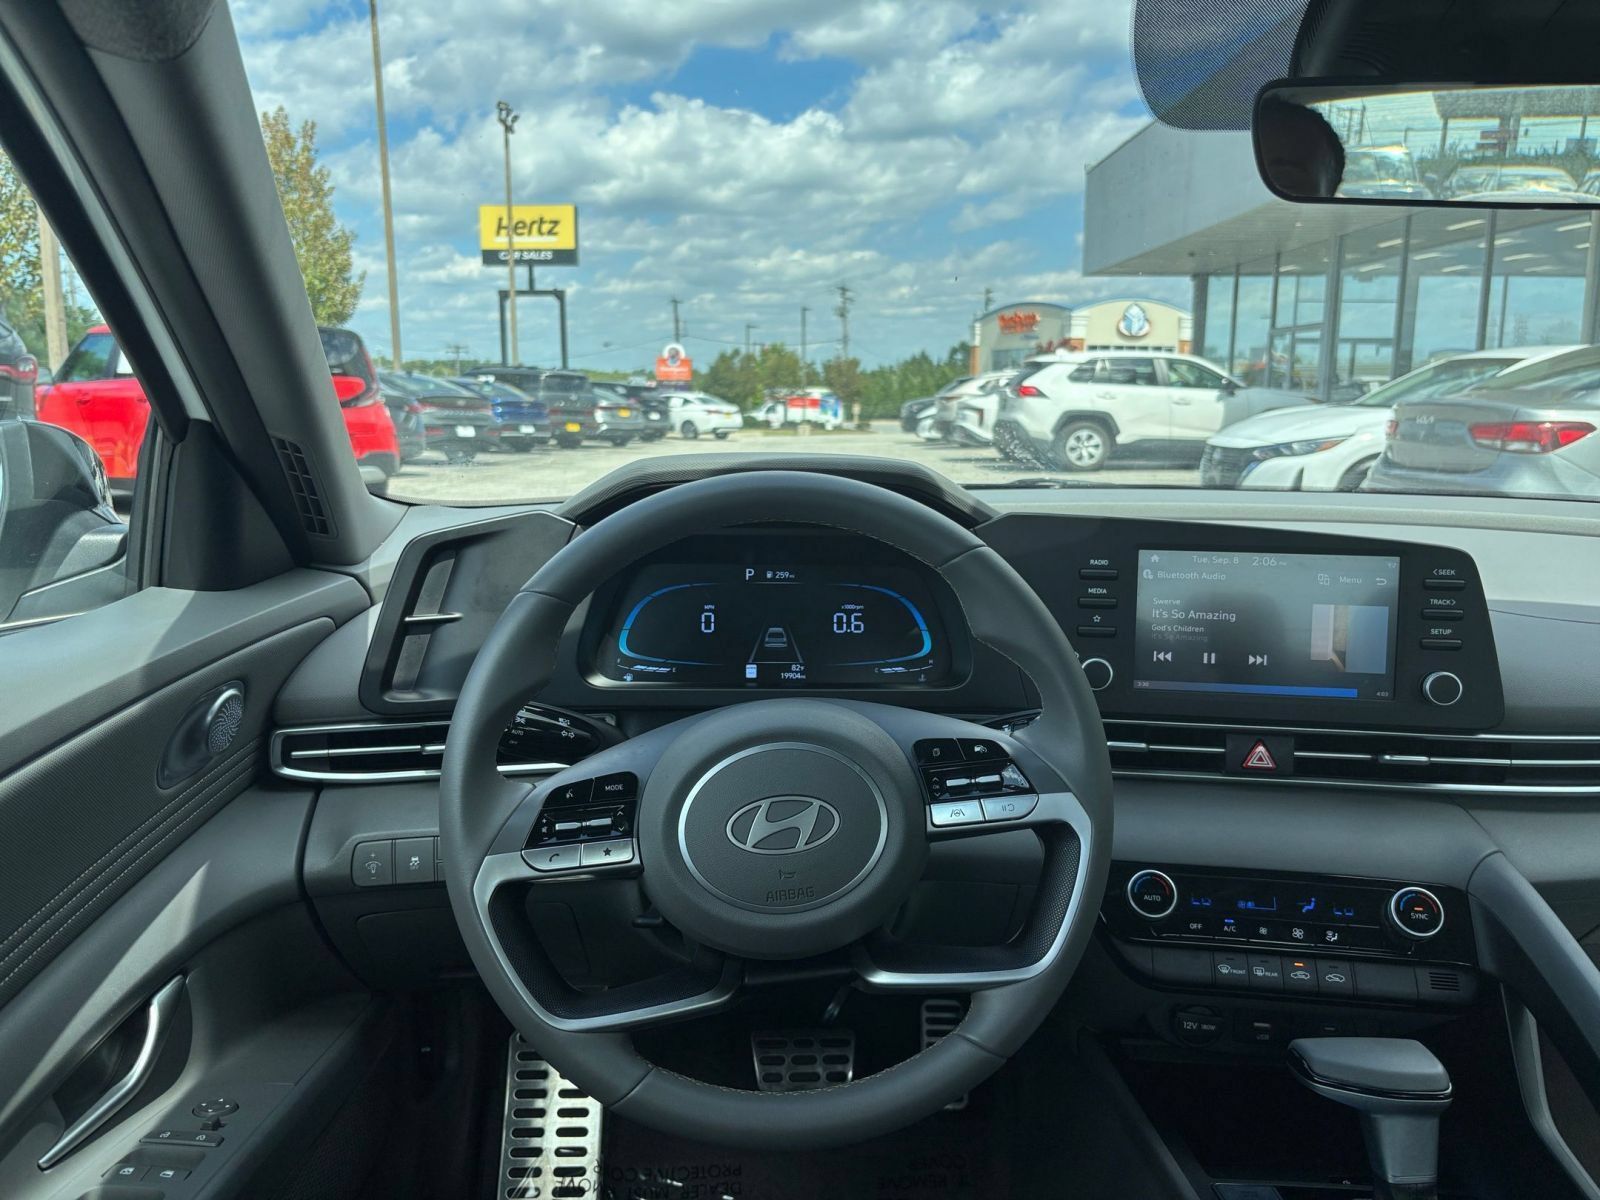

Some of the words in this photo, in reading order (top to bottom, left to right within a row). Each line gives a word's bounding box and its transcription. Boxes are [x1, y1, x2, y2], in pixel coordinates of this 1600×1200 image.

[496, 217, 561, 236] Hertz
[520, 250, 554, 260] SALES
[1192, 555, 1211, 564] Tue.
[1212, 556, 1232, 565] Sep.
[1233, 556, 1240, 564] 8
[1251, 556, 1278, 566] 2:06
[745, 568, 755, 580] P
[1157, 570, 1200, 580] Bluetooth
[1201, 572, 1227, 581] Audio
[1339, 576, 1362, 584] Menu
[1152, 597, 1181, 605] Swerve
[1429, 598, 1451, 606] TRACK
[1152, 608, 1169, 619] It's
[1171, 608, 1186, 619] So
[1188, 610, 1237, 623] Amazing
[701, 612, 715, 633] 0
[833, 612, 864, 633] 0.6
[1151, 623, 1172, 632] God's
[1173, 624, 1205, 633] Children
[604, 783, 625, 792] MODE
[766, 886, 816, 902] AIRBAG
[1143, 894, 1161, 902] AUTO
[1410, 912, 1429, 920] SYNC
[1183, 1021, 1198, 1030] 12V
